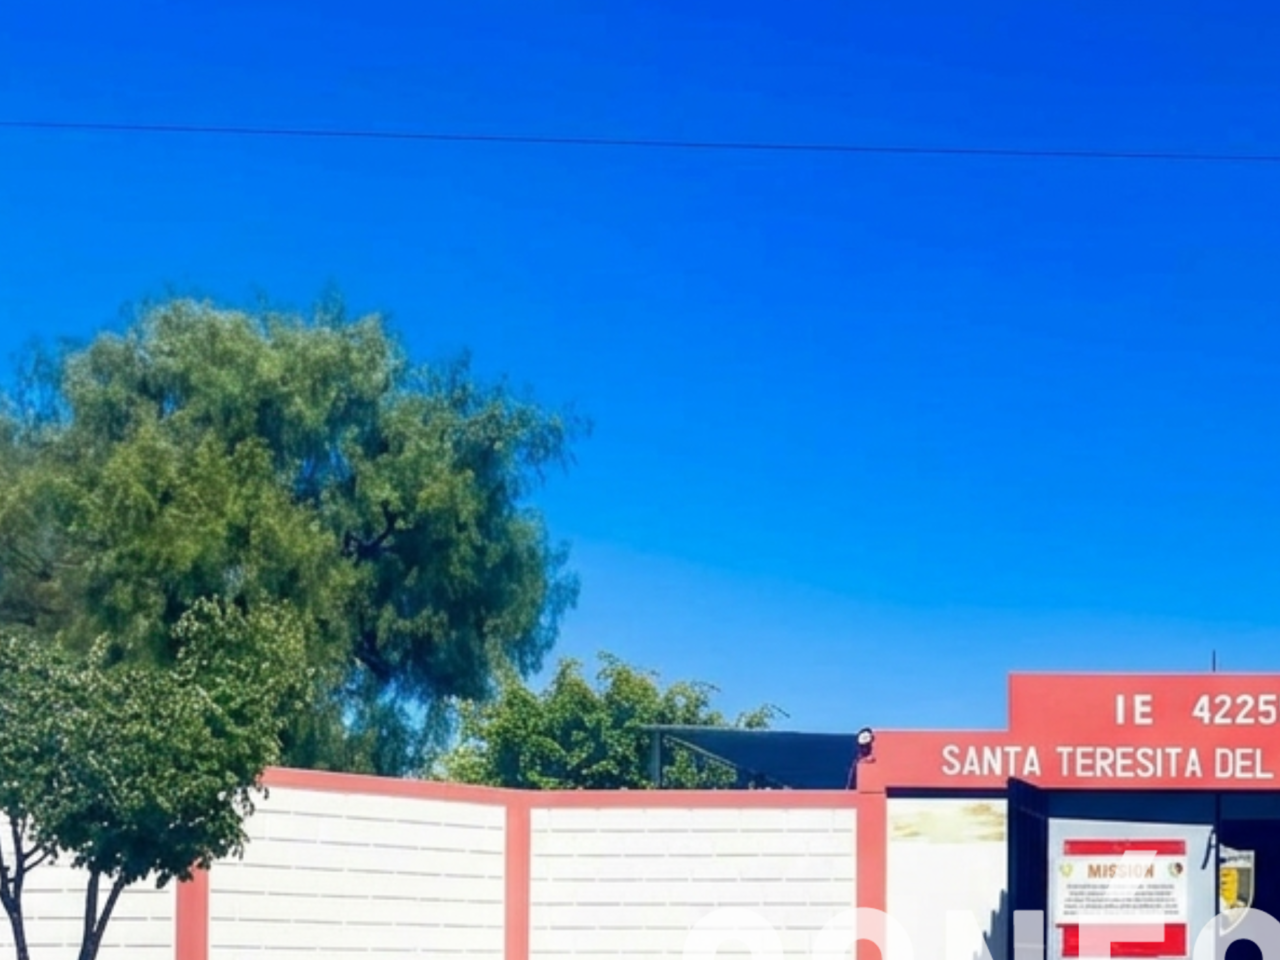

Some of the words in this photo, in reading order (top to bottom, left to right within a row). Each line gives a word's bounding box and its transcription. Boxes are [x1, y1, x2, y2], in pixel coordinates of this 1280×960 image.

[1115, 693, 1153, 725] IE
[941, 743, 1042, 777] SANTA
[1055, 745, 1203, 779] TERESITA
[1214, 747, 1275, 780] DEL
